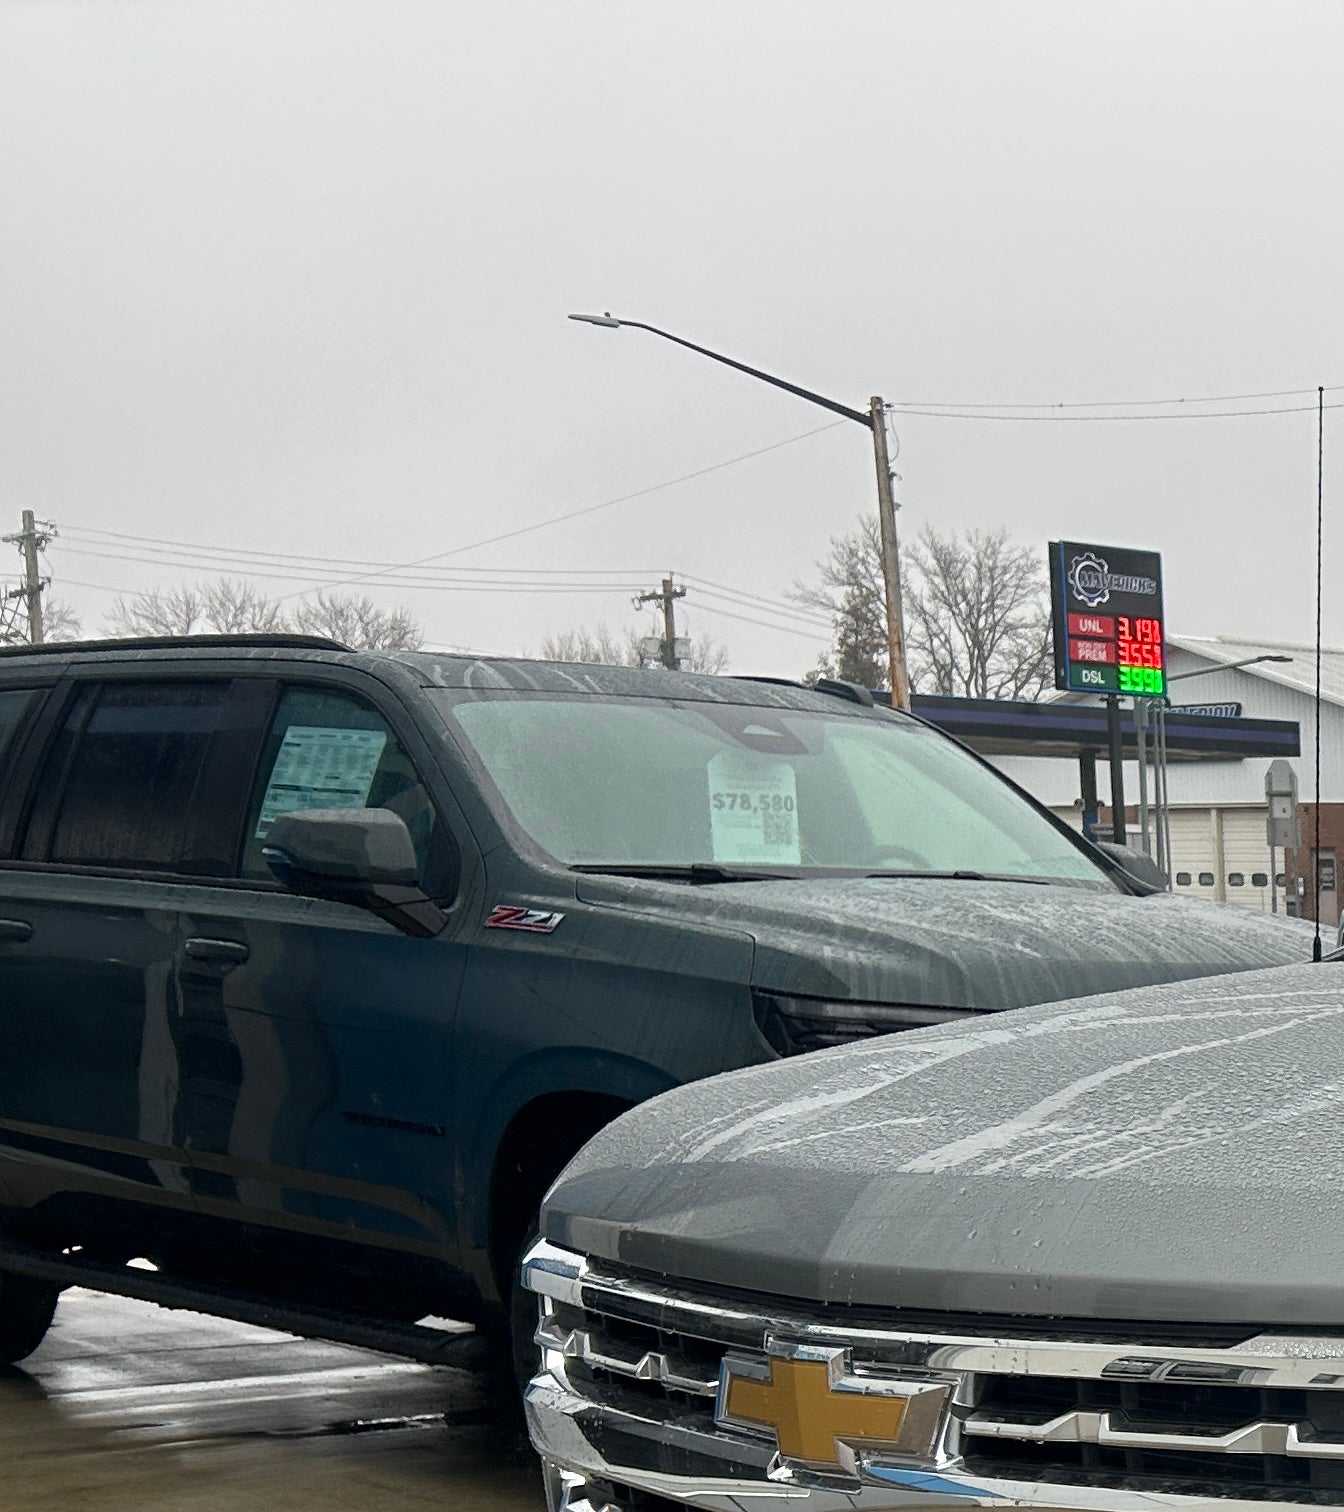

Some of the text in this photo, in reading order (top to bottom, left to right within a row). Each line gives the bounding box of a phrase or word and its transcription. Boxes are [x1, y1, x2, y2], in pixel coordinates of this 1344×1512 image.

[1079, 618, 1104, 633] UNL
[1078, 647, 1107, 662] PREM
[1081, 669, 1106, 684] DSL
[712, 792, 794, 813] $78,580
[484, 904, 567, 933] Z71
